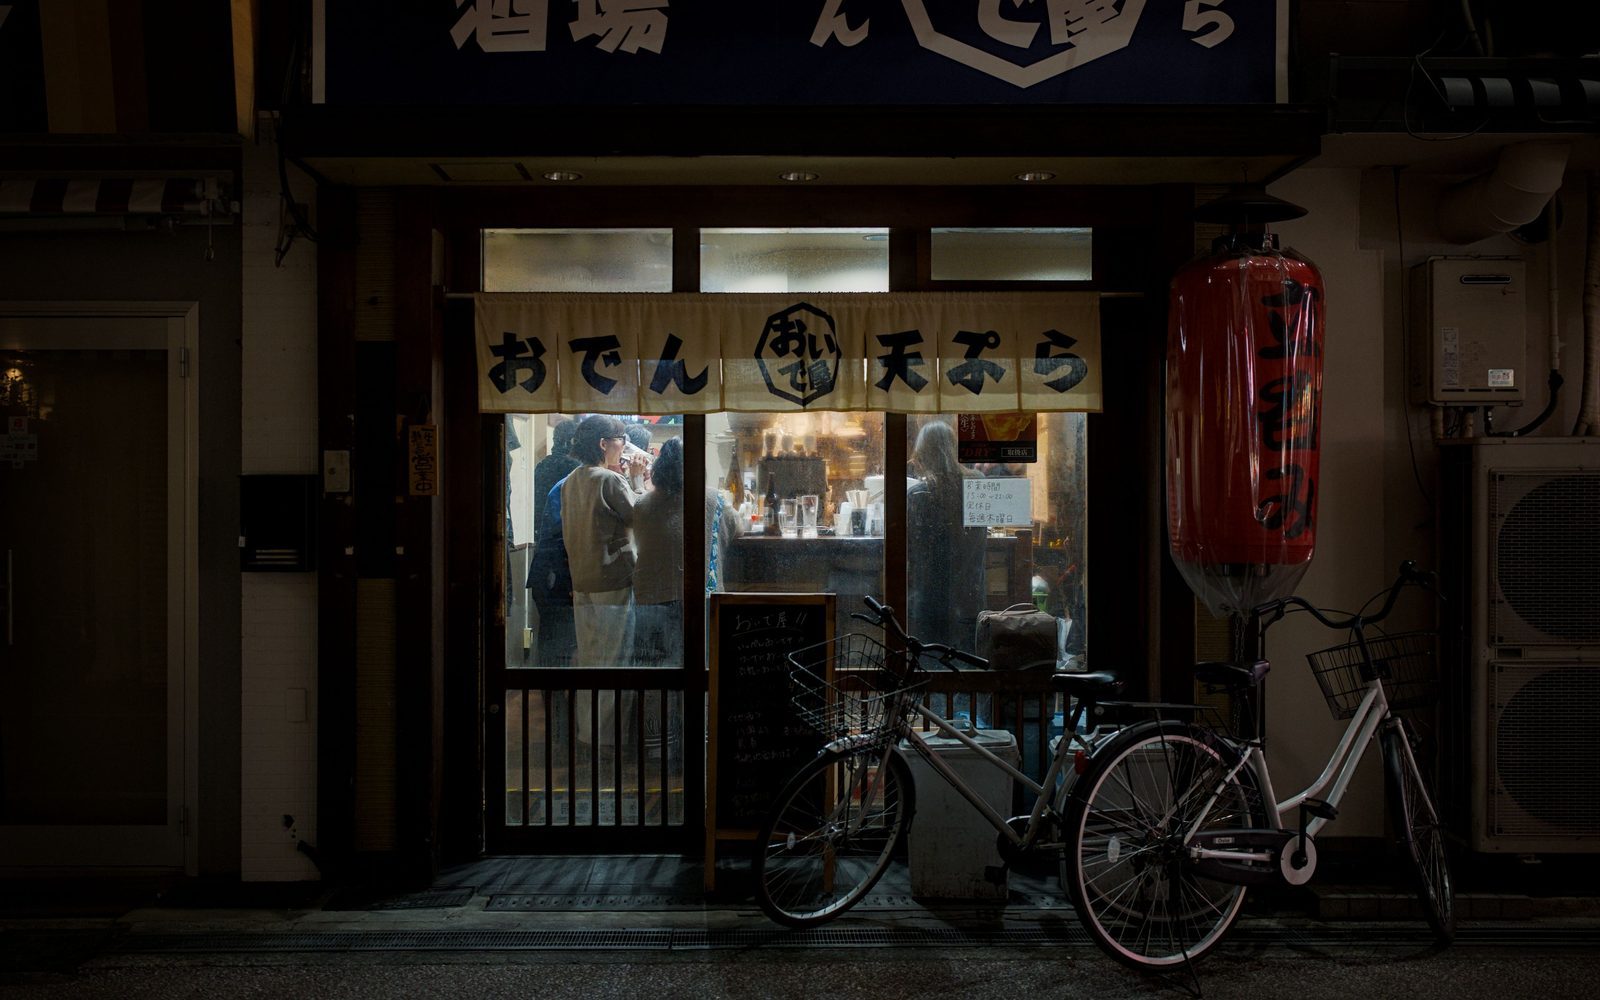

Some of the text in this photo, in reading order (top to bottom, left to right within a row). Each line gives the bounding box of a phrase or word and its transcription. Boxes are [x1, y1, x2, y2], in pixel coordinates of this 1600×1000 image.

[487, 332, 708, 395] おでん
[875, 329, 1089, 395] 天ぷら
